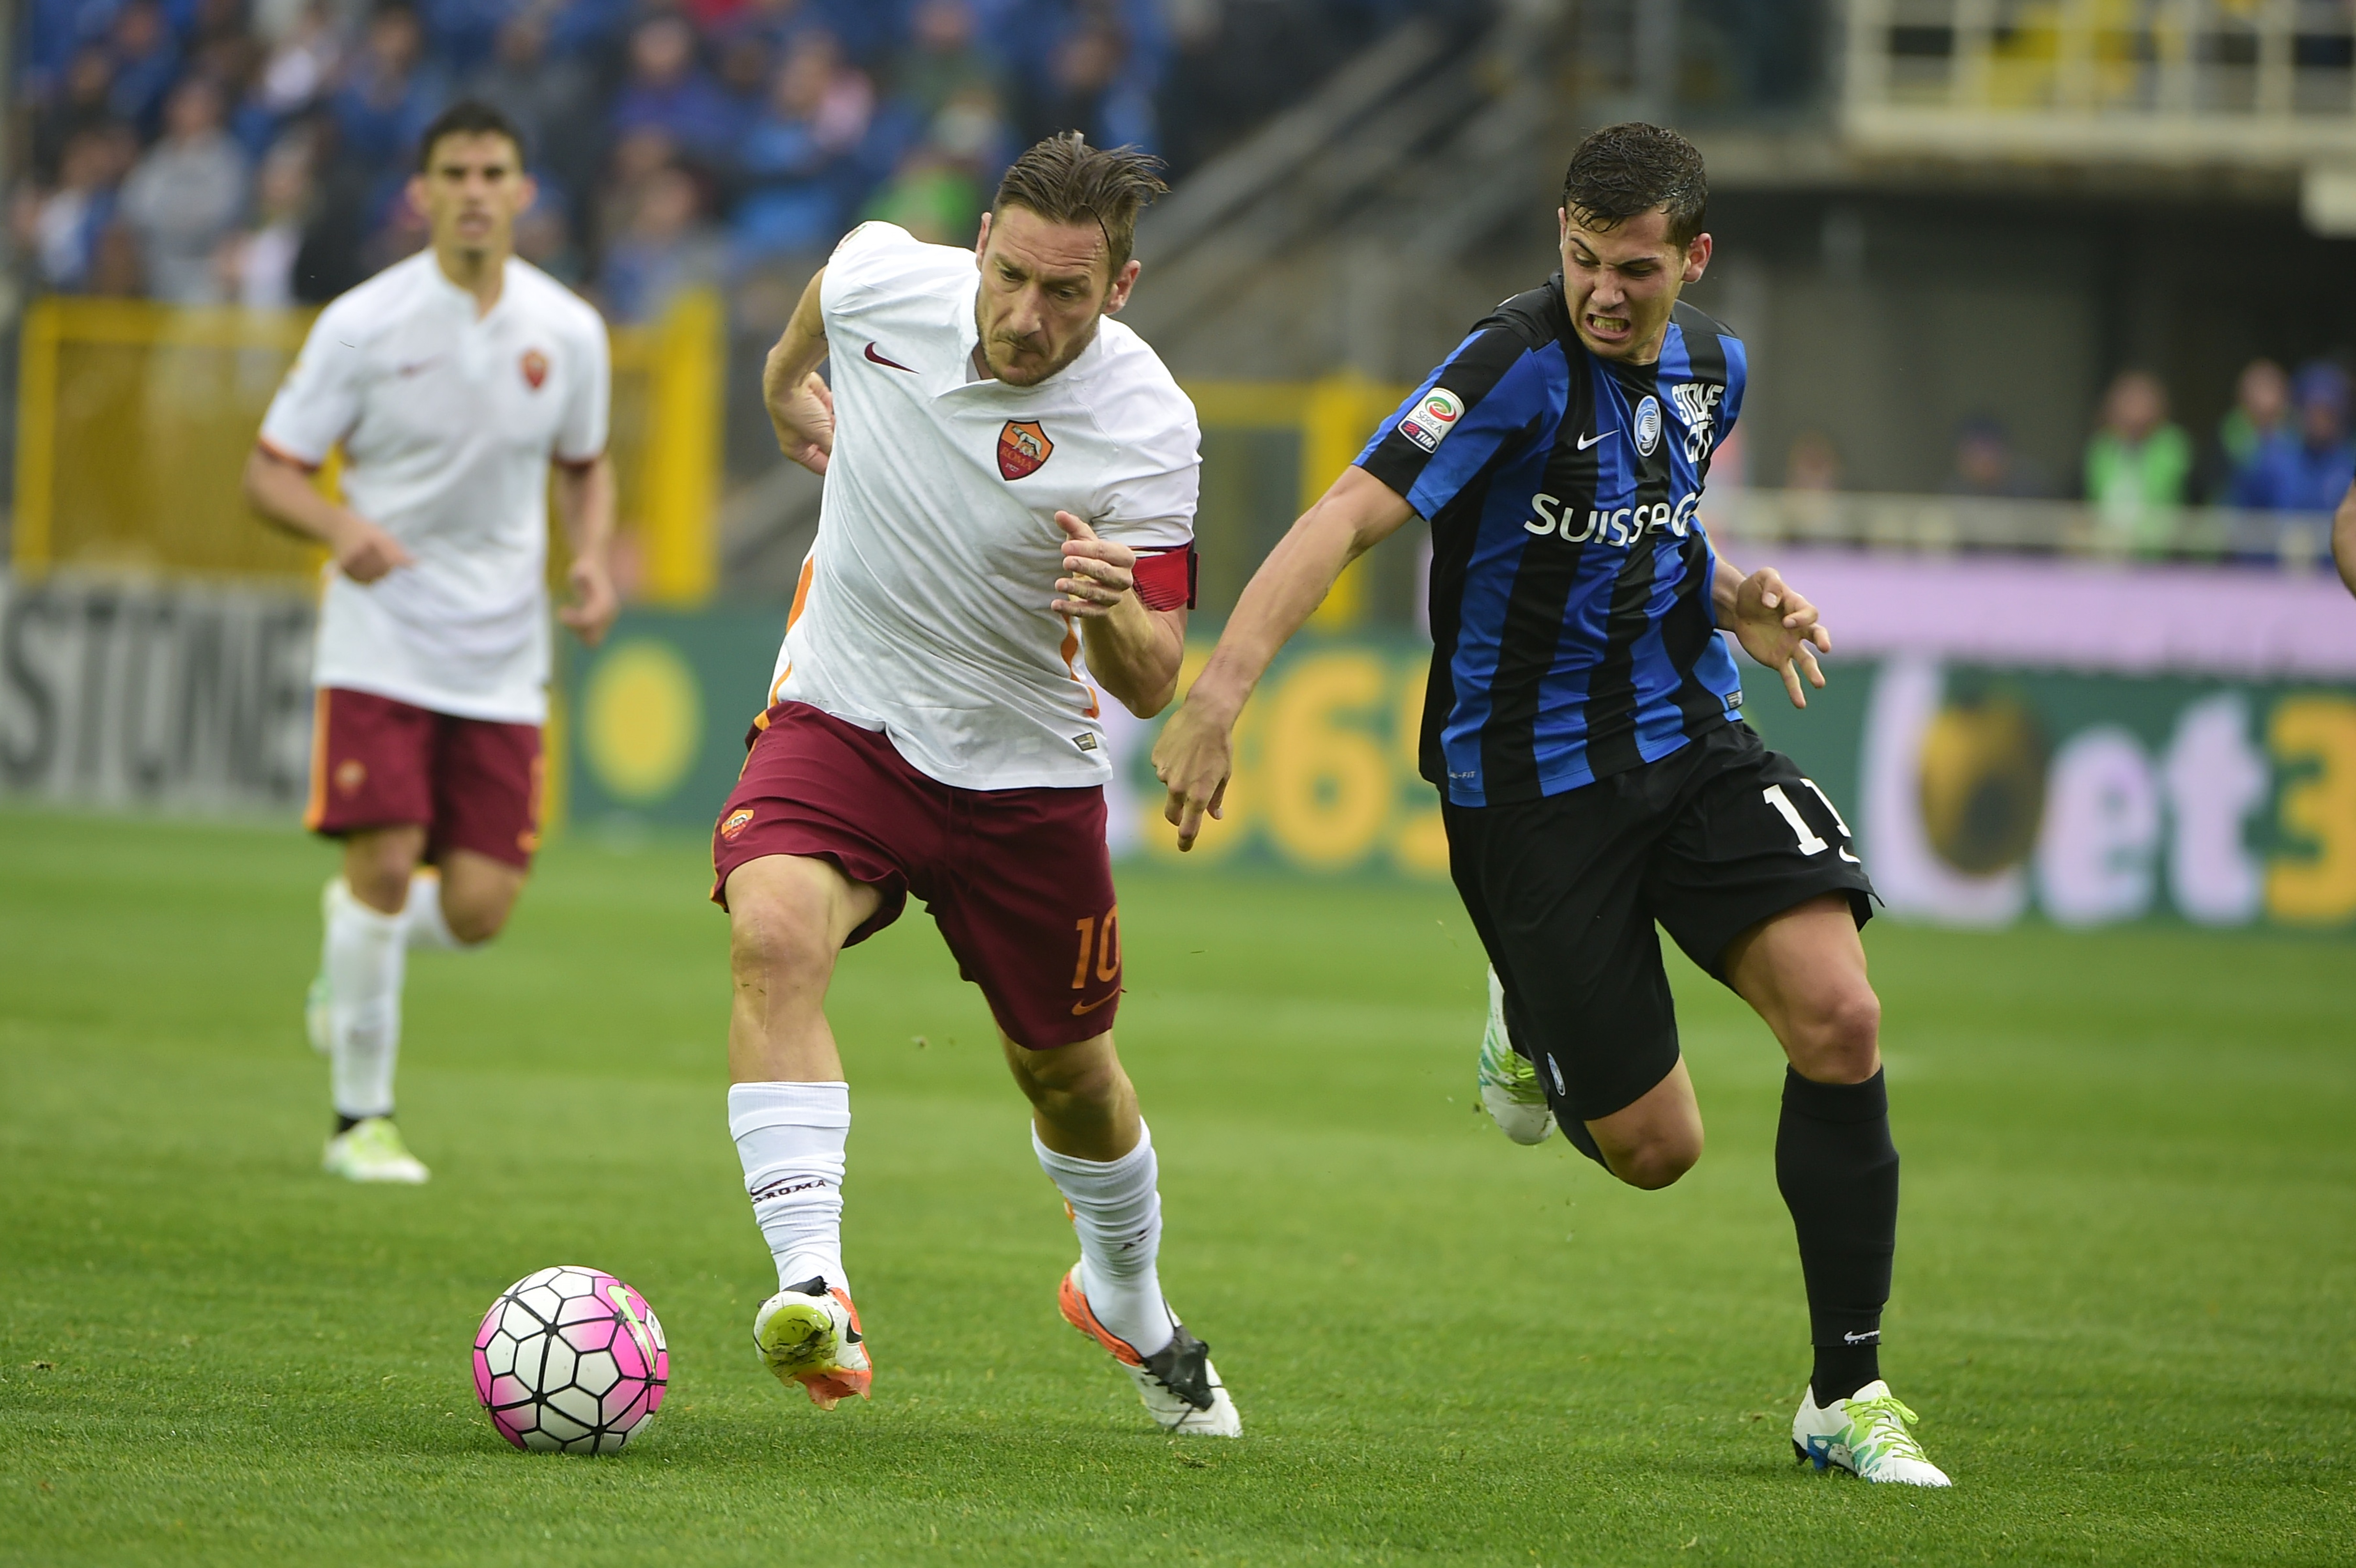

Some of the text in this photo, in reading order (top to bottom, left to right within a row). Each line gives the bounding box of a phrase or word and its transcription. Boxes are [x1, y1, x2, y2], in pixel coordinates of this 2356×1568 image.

[1671, 383, 1725, 426] STONE
[1416, 410, 1443, 434] SERIE A
[1415, 430, 1436, 448] TIM
[1000, 446, 1032, 471] ROMA
[1071, 905, 1121, 989] 10
